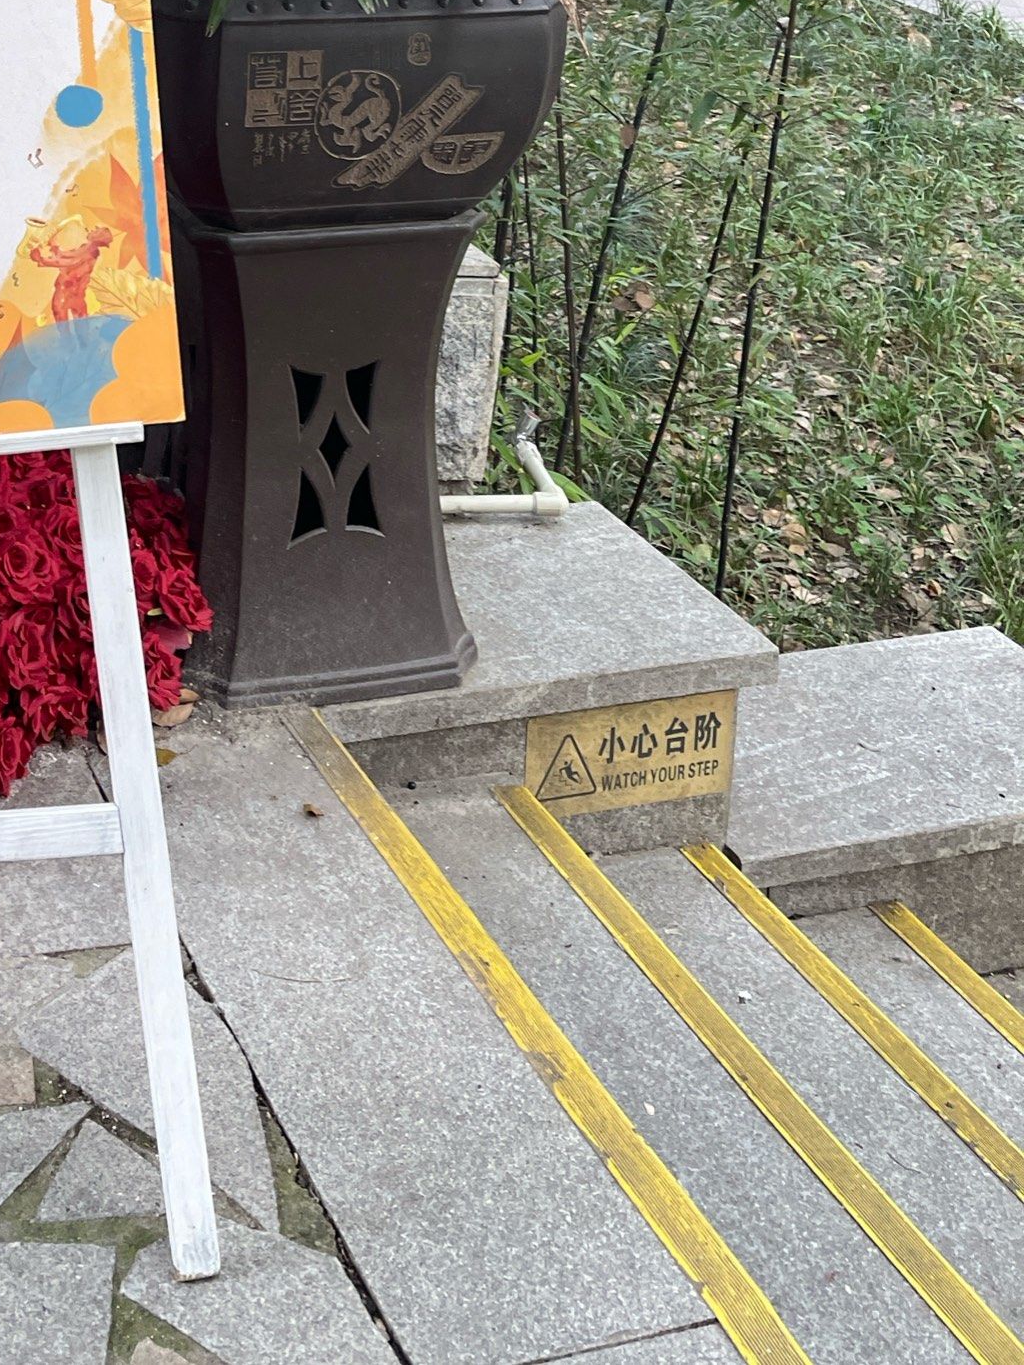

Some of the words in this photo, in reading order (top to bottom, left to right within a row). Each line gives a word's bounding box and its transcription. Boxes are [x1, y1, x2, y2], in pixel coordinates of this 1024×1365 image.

[598, 711, 722, 764] 小心台阶
[601, 770, 647, 792] WATCH
[651, 765, 685, 784] YOUR
[688, 759, 719, 779] STEP
